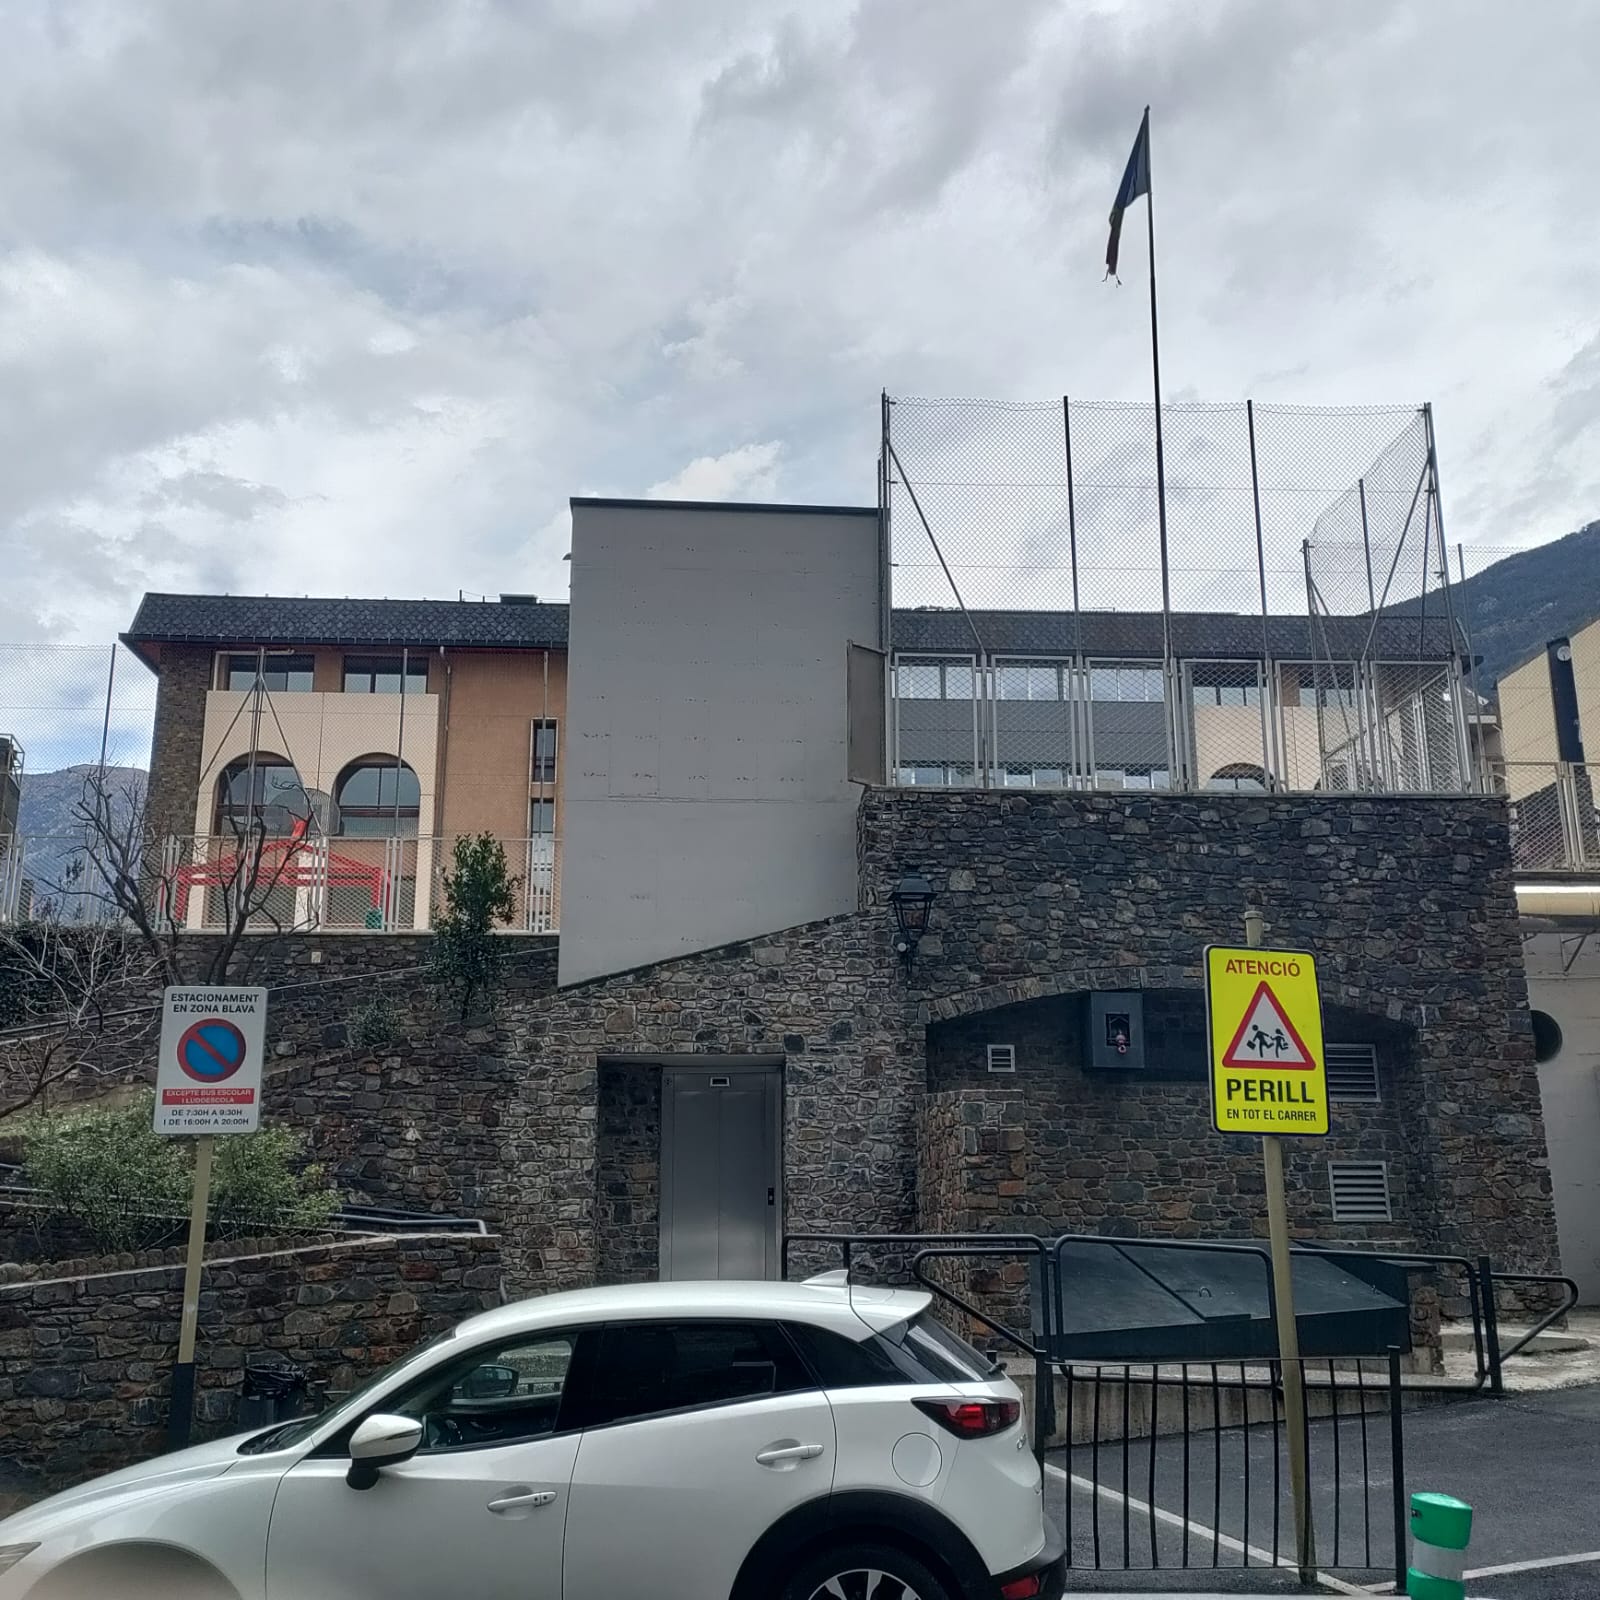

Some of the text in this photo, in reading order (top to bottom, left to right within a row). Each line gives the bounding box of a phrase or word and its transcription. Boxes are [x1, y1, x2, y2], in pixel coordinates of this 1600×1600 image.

[1226, 958, 1301, 977] ATENCIÓ
[171, 993, 259, 1003] ESTACIONAMENT
[173, 1004, 255, 1013] EN ZONA BLAVA
[217, 1088, 251, 1096] ESCOLAR
[1226, 1078, 1315, 1103] PERILL
[1226, 1108, 1317, 1121] EN TOT EL CARRER
